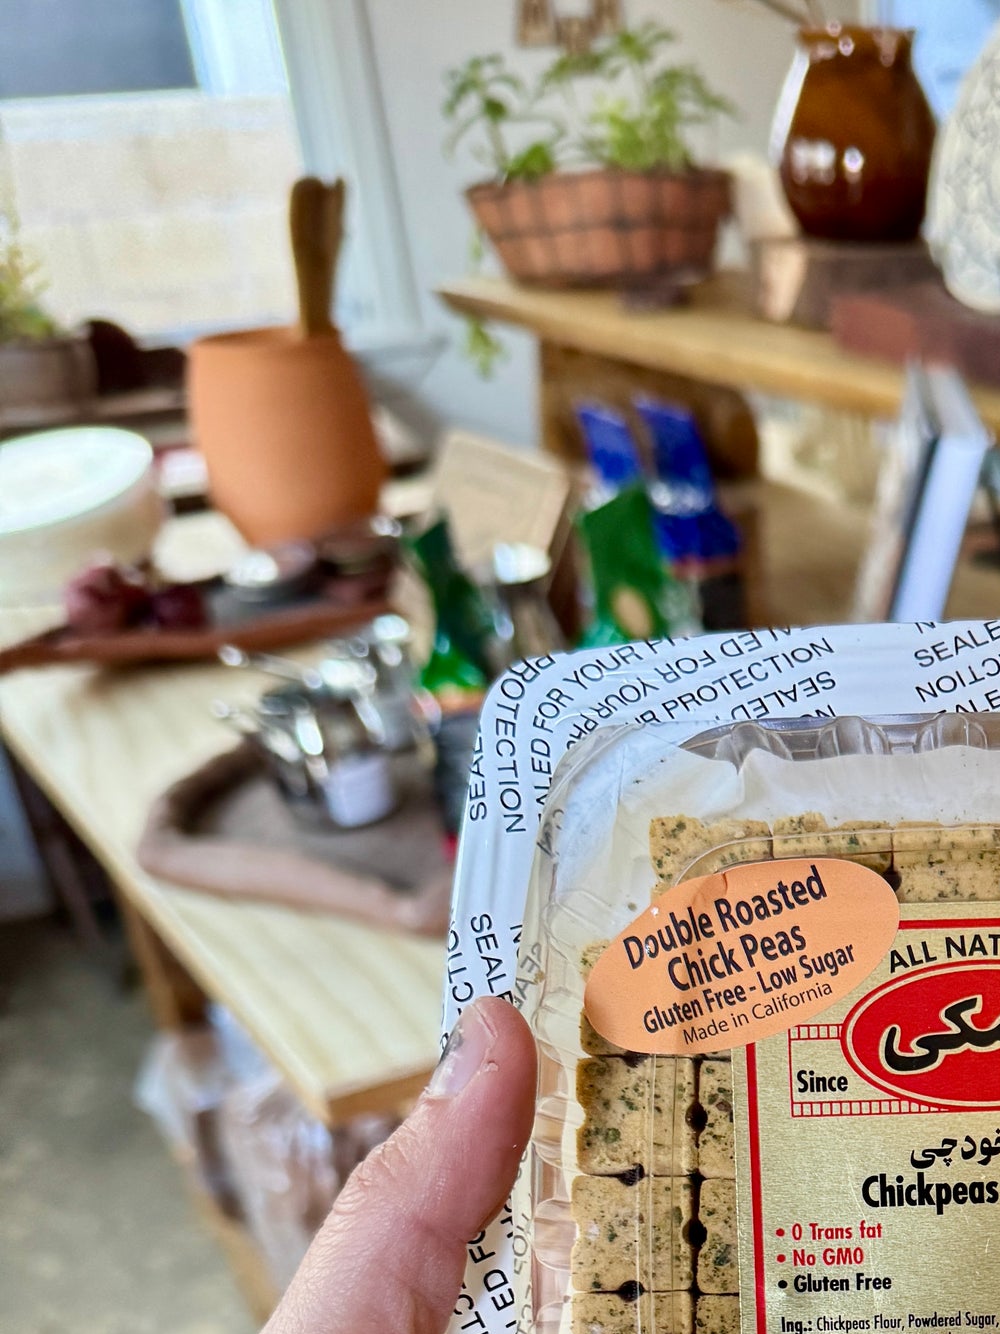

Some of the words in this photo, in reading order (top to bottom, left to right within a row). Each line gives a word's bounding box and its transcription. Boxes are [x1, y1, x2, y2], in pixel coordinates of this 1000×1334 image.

[563, 645, 642, 690] YOUR
[661, 638, 835, 719] PROTECTION
[496, 654, 556, 833] PROTECTION
[623, 906, 716, 970] Double
[714, 865, 827, 932] Roasted
[667, 941, 743, 991] Chick
[740, 925, 807, 968] Peas
[890, 941, 937, 974] ALL
[643, 1000, 709, 1034] Gluten
[702, 984, 747, 1013] Free
[757, 964, 798, 994] Low
[799, 943, 855, 977] Sugar
[682, 1019, 729, 1045] Made
[731, 1012, 749, 1028] in
[751, 981, 833, 1020] California
[797, 1070, 848, 1093] Since
[862, 1172, 999, 1215] Chickpeas
[792, 1223, 802, 1241] 0
[809, 1223, 852, 1240] Trans
[859, 1220, 882, 1238] fat
[793, 1249, 816, 1267] No
[822, 1247, 864, 1266] GMO
[793, 1273, 850, 1293] Gluten
[856, 1273, 892, 1291] Free
[816, 1315, 870, 1334] Chickpeas
[874, 1313, 905, 1331] Flour,
[908, 1310, 961, 1328] Powdered
[965, 1311, 999, 1329] Sugar,
